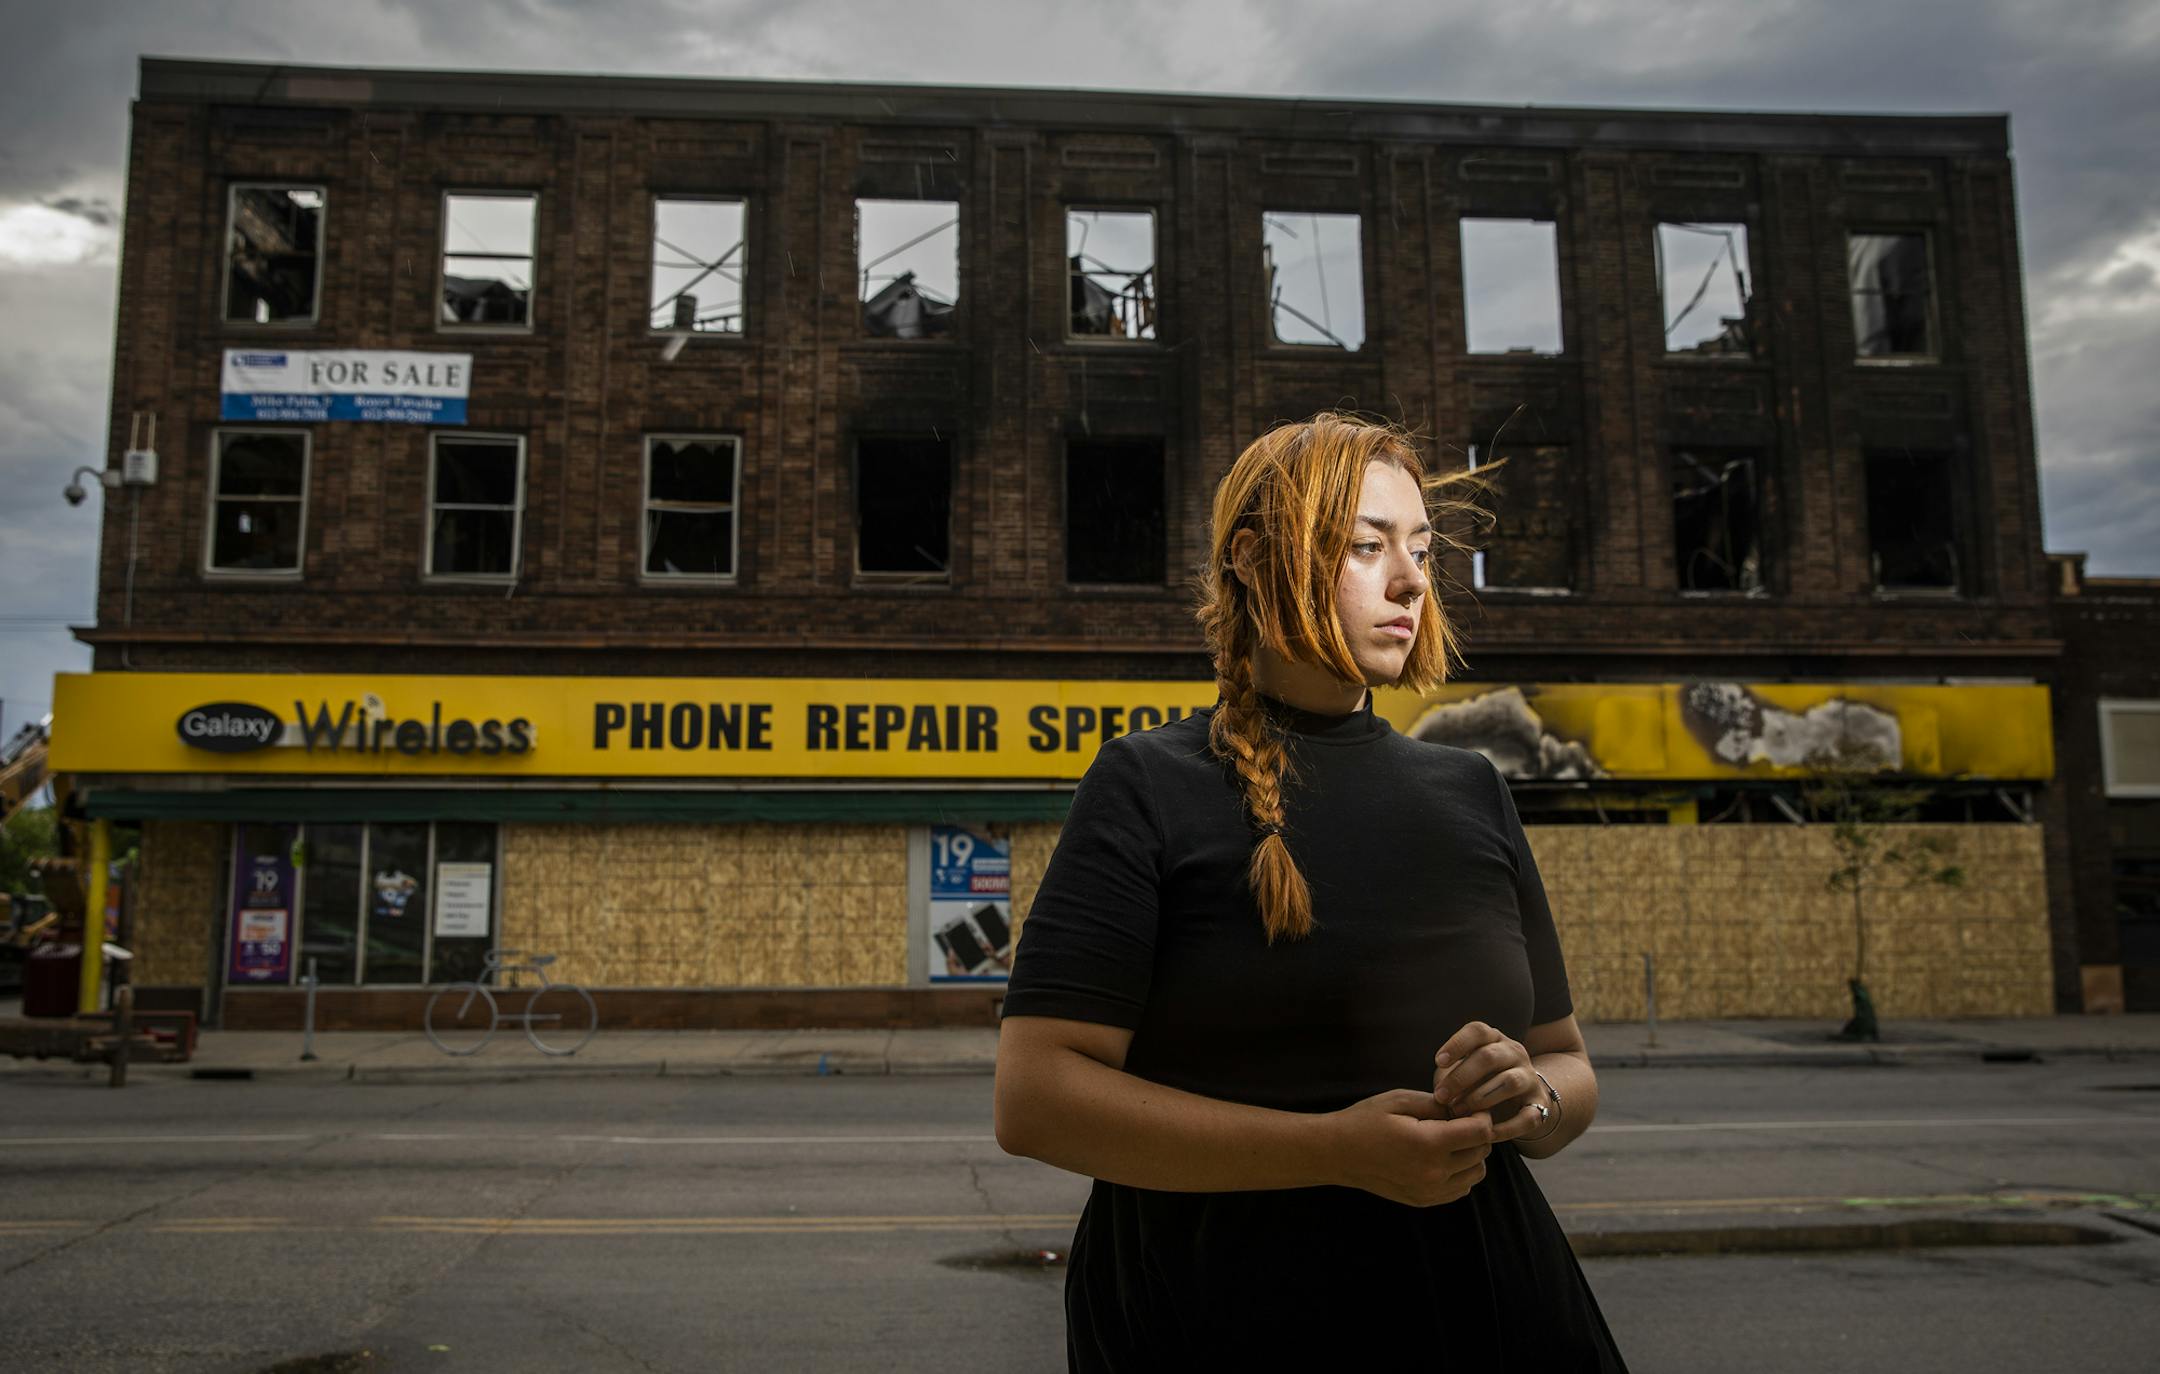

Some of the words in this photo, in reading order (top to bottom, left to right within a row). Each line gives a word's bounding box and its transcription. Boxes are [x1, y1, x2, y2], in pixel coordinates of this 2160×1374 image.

[310, 361, 368, 385] FOR
[381, 361, 462, 388] SALE
[182, 711, 275, 741] Galaxy
[295, 700, 531, 755] Wireless
[593, 702, 774, 751] PHONE
[805, 703, 999, 753] REPAIR
[935, 833, 975, 868] 19
